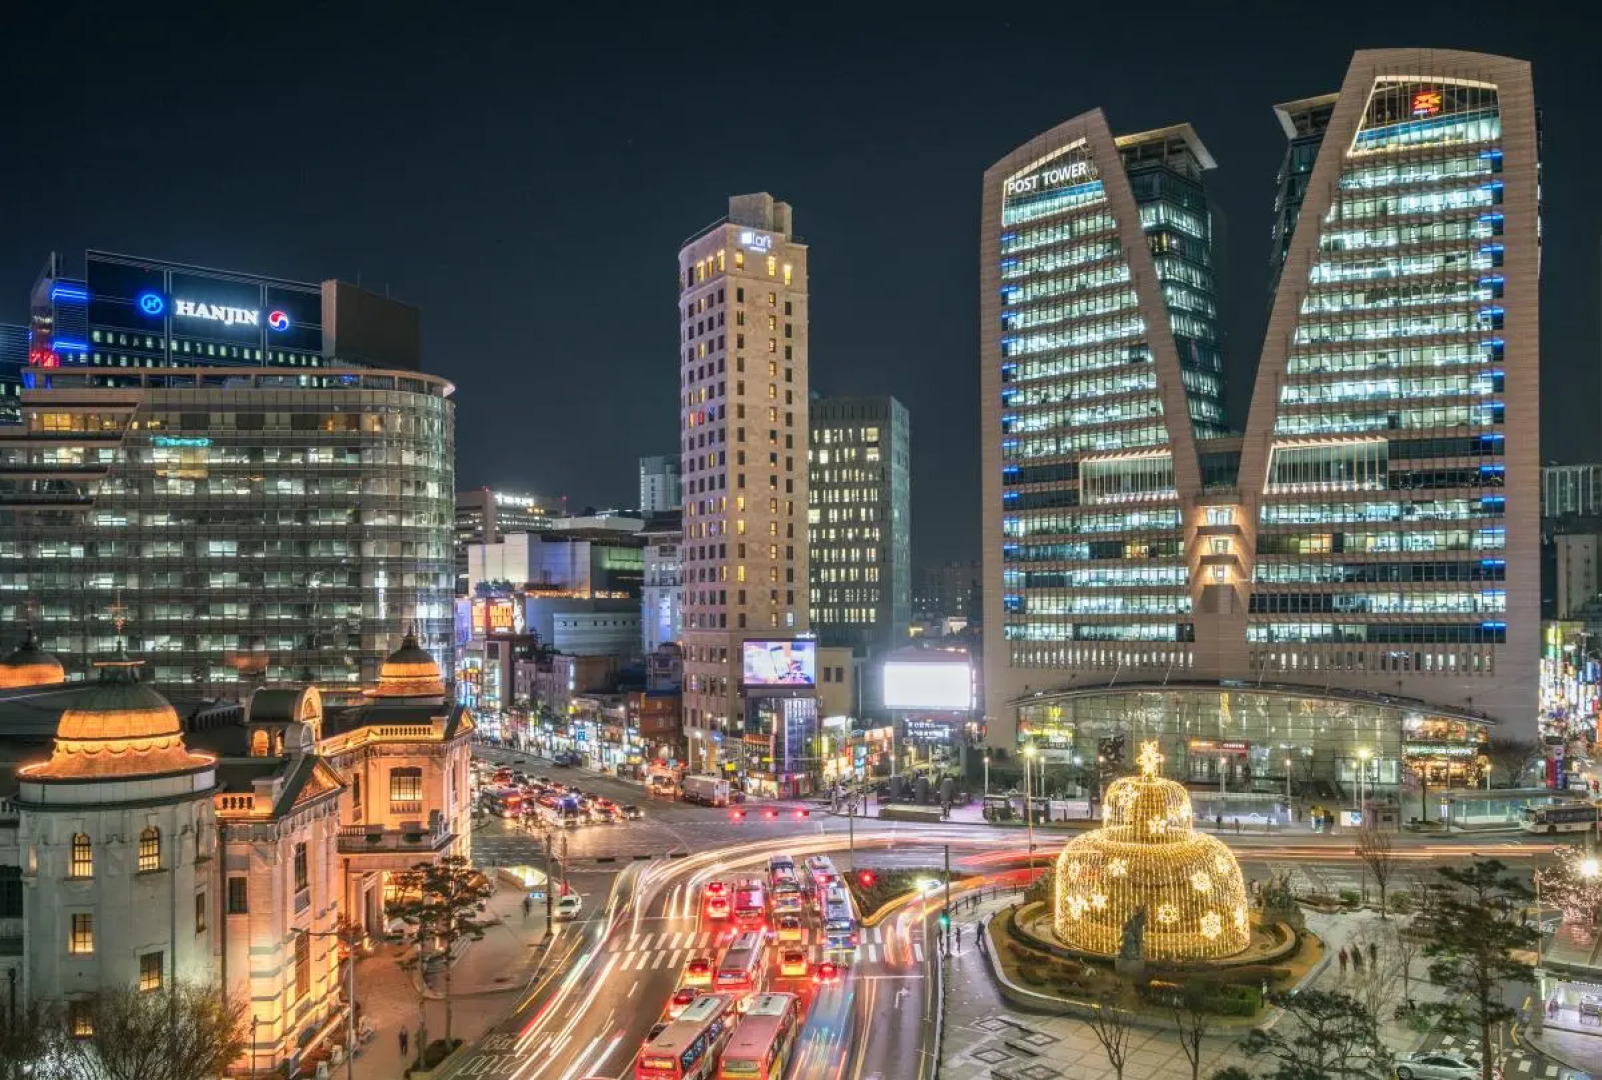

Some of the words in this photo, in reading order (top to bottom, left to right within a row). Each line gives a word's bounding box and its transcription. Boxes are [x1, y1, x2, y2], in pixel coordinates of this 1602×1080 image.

[1007, 175, 1039, 195] POST
[1042, 162, 1086, 186] TOWER
[175, 299, 260, 326] HANJIN
